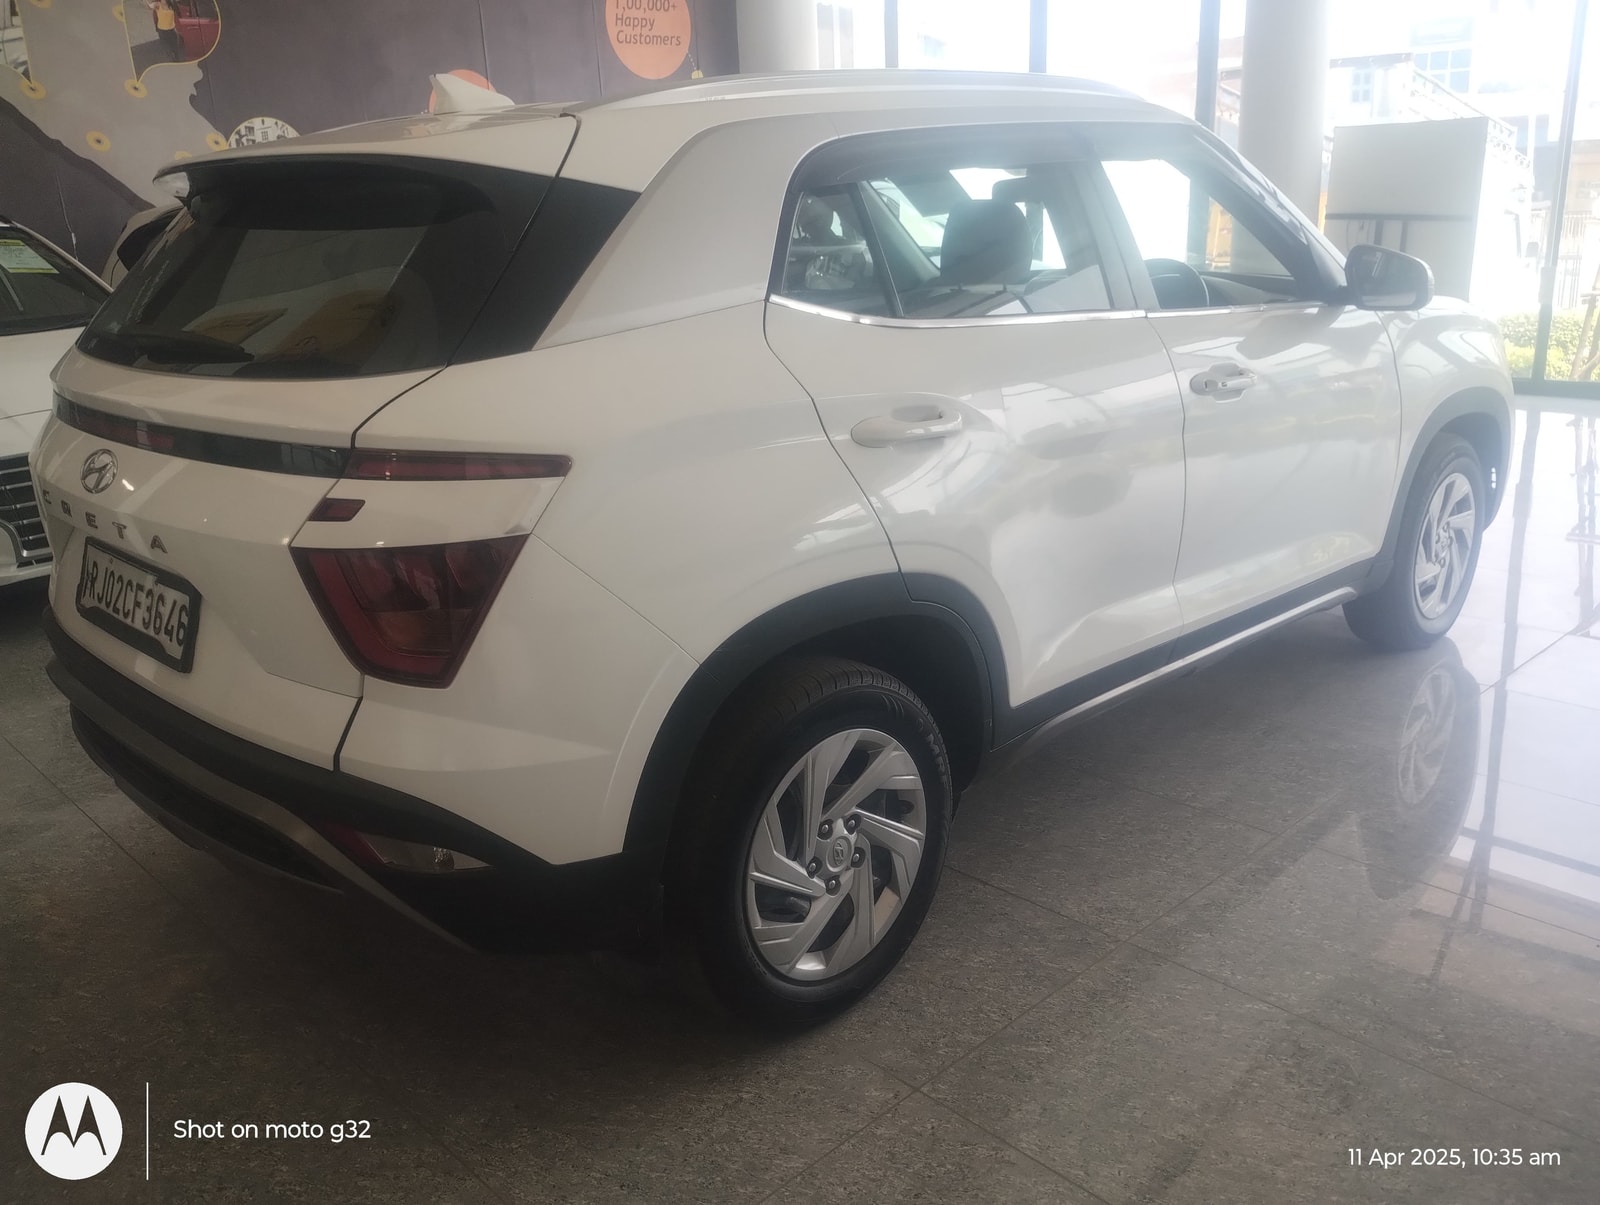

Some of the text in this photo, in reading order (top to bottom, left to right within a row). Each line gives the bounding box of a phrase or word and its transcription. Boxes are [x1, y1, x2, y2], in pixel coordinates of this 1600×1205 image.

[615, 13, 656, 32] Happy
[616, 30, 682, 47] Customers
[42, 489, 168, 554] CRETA
